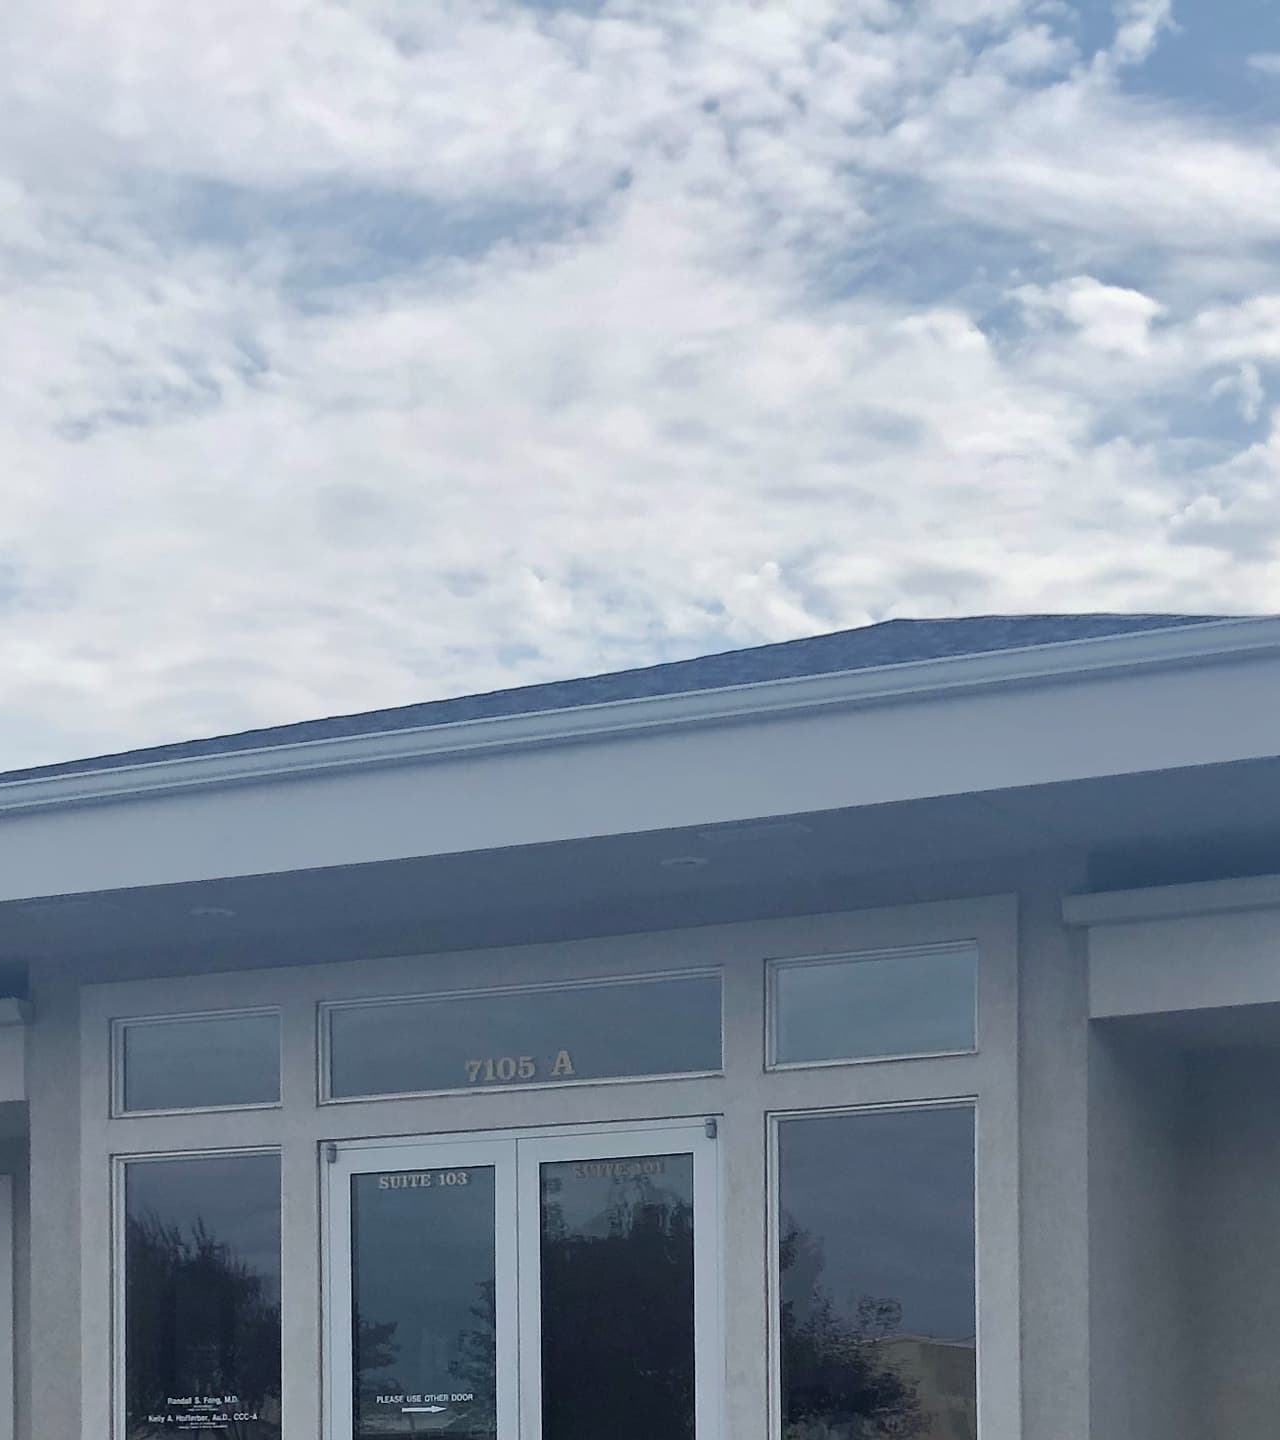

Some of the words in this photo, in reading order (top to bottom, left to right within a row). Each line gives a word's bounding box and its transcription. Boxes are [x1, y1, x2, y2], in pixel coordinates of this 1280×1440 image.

[465, 1056, 536, 1082] 7105
[551, 1050, 575, 1076] A
[379, 1174, 431, 1189] SUITE
[439, 1172, 468, 1186] 103
[376, 1395, 403, 1404] PLEASE
[406, 1395, 422, 1403] USE
[424, 1394, 449, 1402] OTHER
[451, 1393, 473, 1402] DOOR
